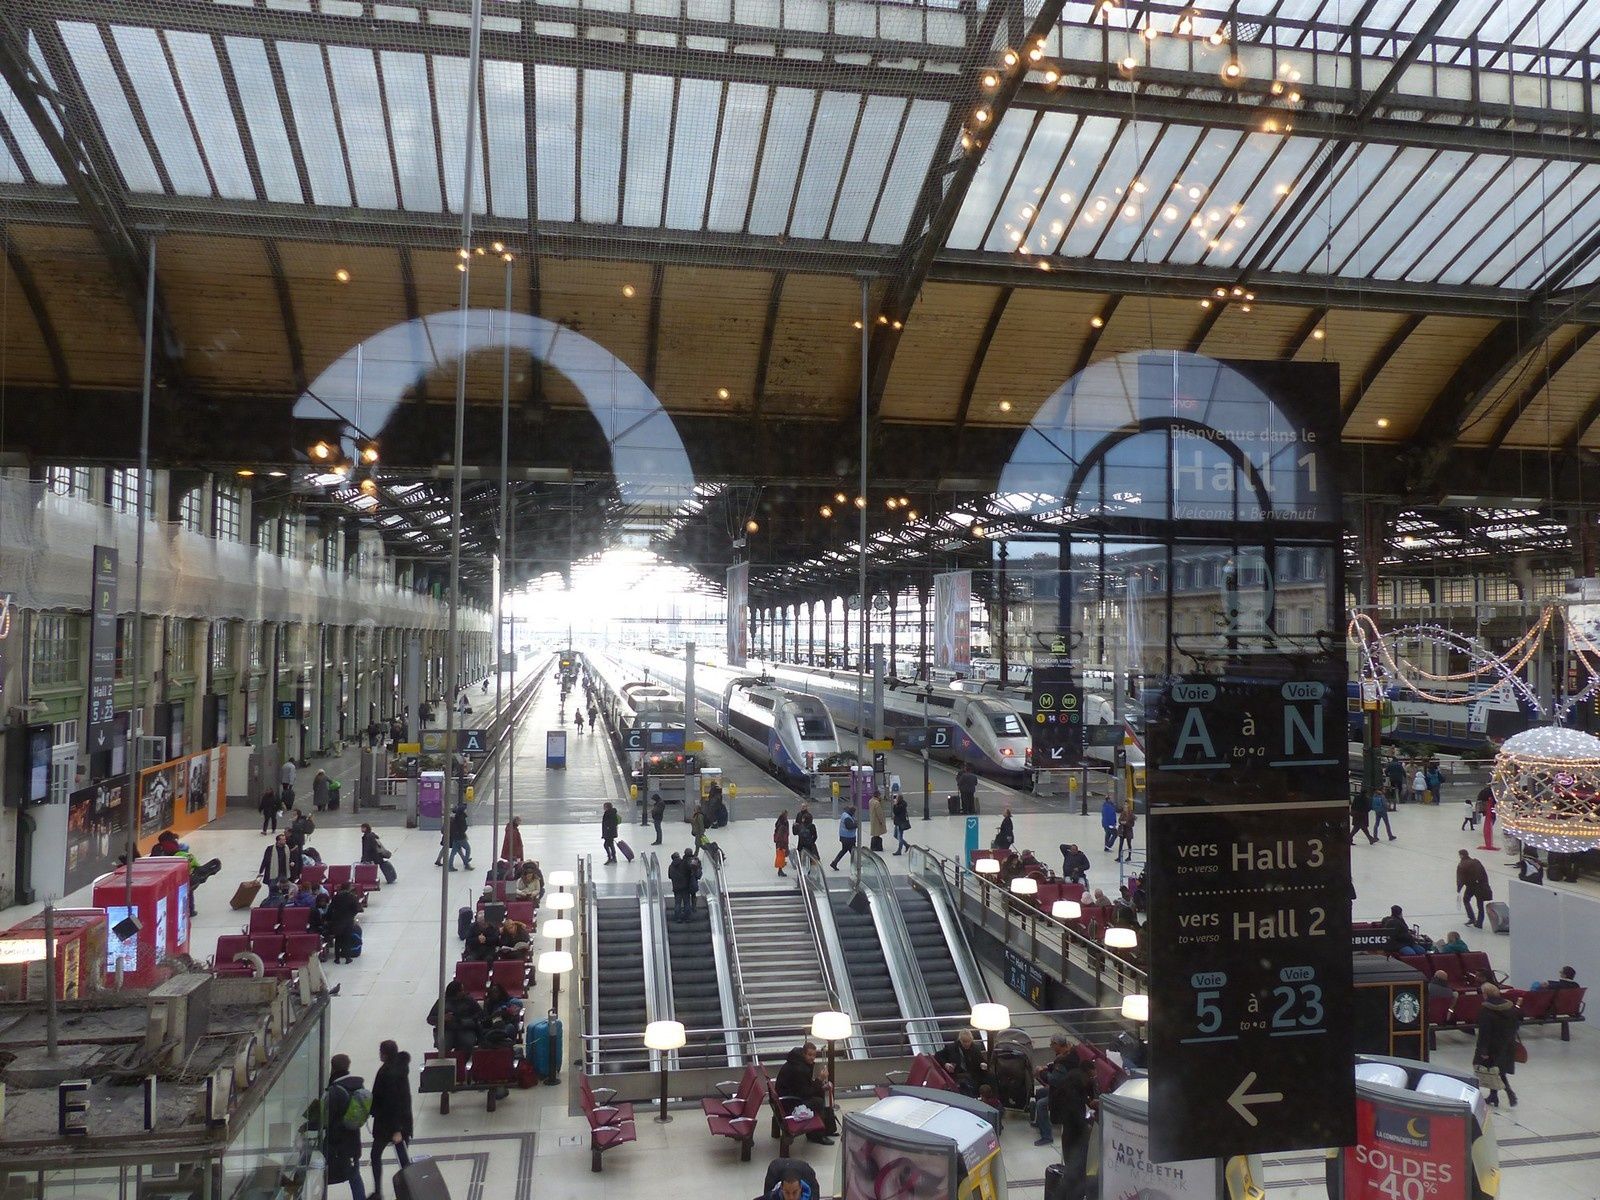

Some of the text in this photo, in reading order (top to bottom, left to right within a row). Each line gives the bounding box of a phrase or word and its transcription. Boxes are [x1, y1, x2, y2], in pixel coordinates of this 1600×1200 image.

[1170, 424, 1316, 443] Bienvenue dans le
[1172, 449, 1318, 492] Hall 1
[1175, 506, 1318, 520] Welcome Benvenuti
[103, 591, 110, 608] P
[93, 684, 113, 697] Hall 2
[1177, 686, 1210, 700] Voie
[1287, 684, 1318, 698] Voie
[92, 706, 99, 721] 5
[104, 704, 114, 719] 23
[935, 732, 947, 745] D
[1173, 704, 1324, 759] A à N
[467, 736, 479, 748] A
[629, 735, 641, 747] C
[1232, 745, 1265, 757] to a
[1177, 838, 1325, 871] vers Hall 3
[1177, 864, 1218, 874] to verso
[1178, 906, 1326, 941] vers Hall 2
[1178, 934, 1220, 944] to verso
[1196, 973, 1222, 986] Voie
[1285, 968, 1310, 981] Voie
[1197, 984, 1324, 1033] 5 à 23
[1240, 1020, 1266, 1031] to a
[1376, 1130, 1383, 1138] LA
[1112, 1139, 1144, 1159] LADY
[1116, 1152, 1184, 1179] MACBETH
[1356, 1144, 1452, 1183] SOLDES
[1368, 1173, 1438, 1200] -40%
